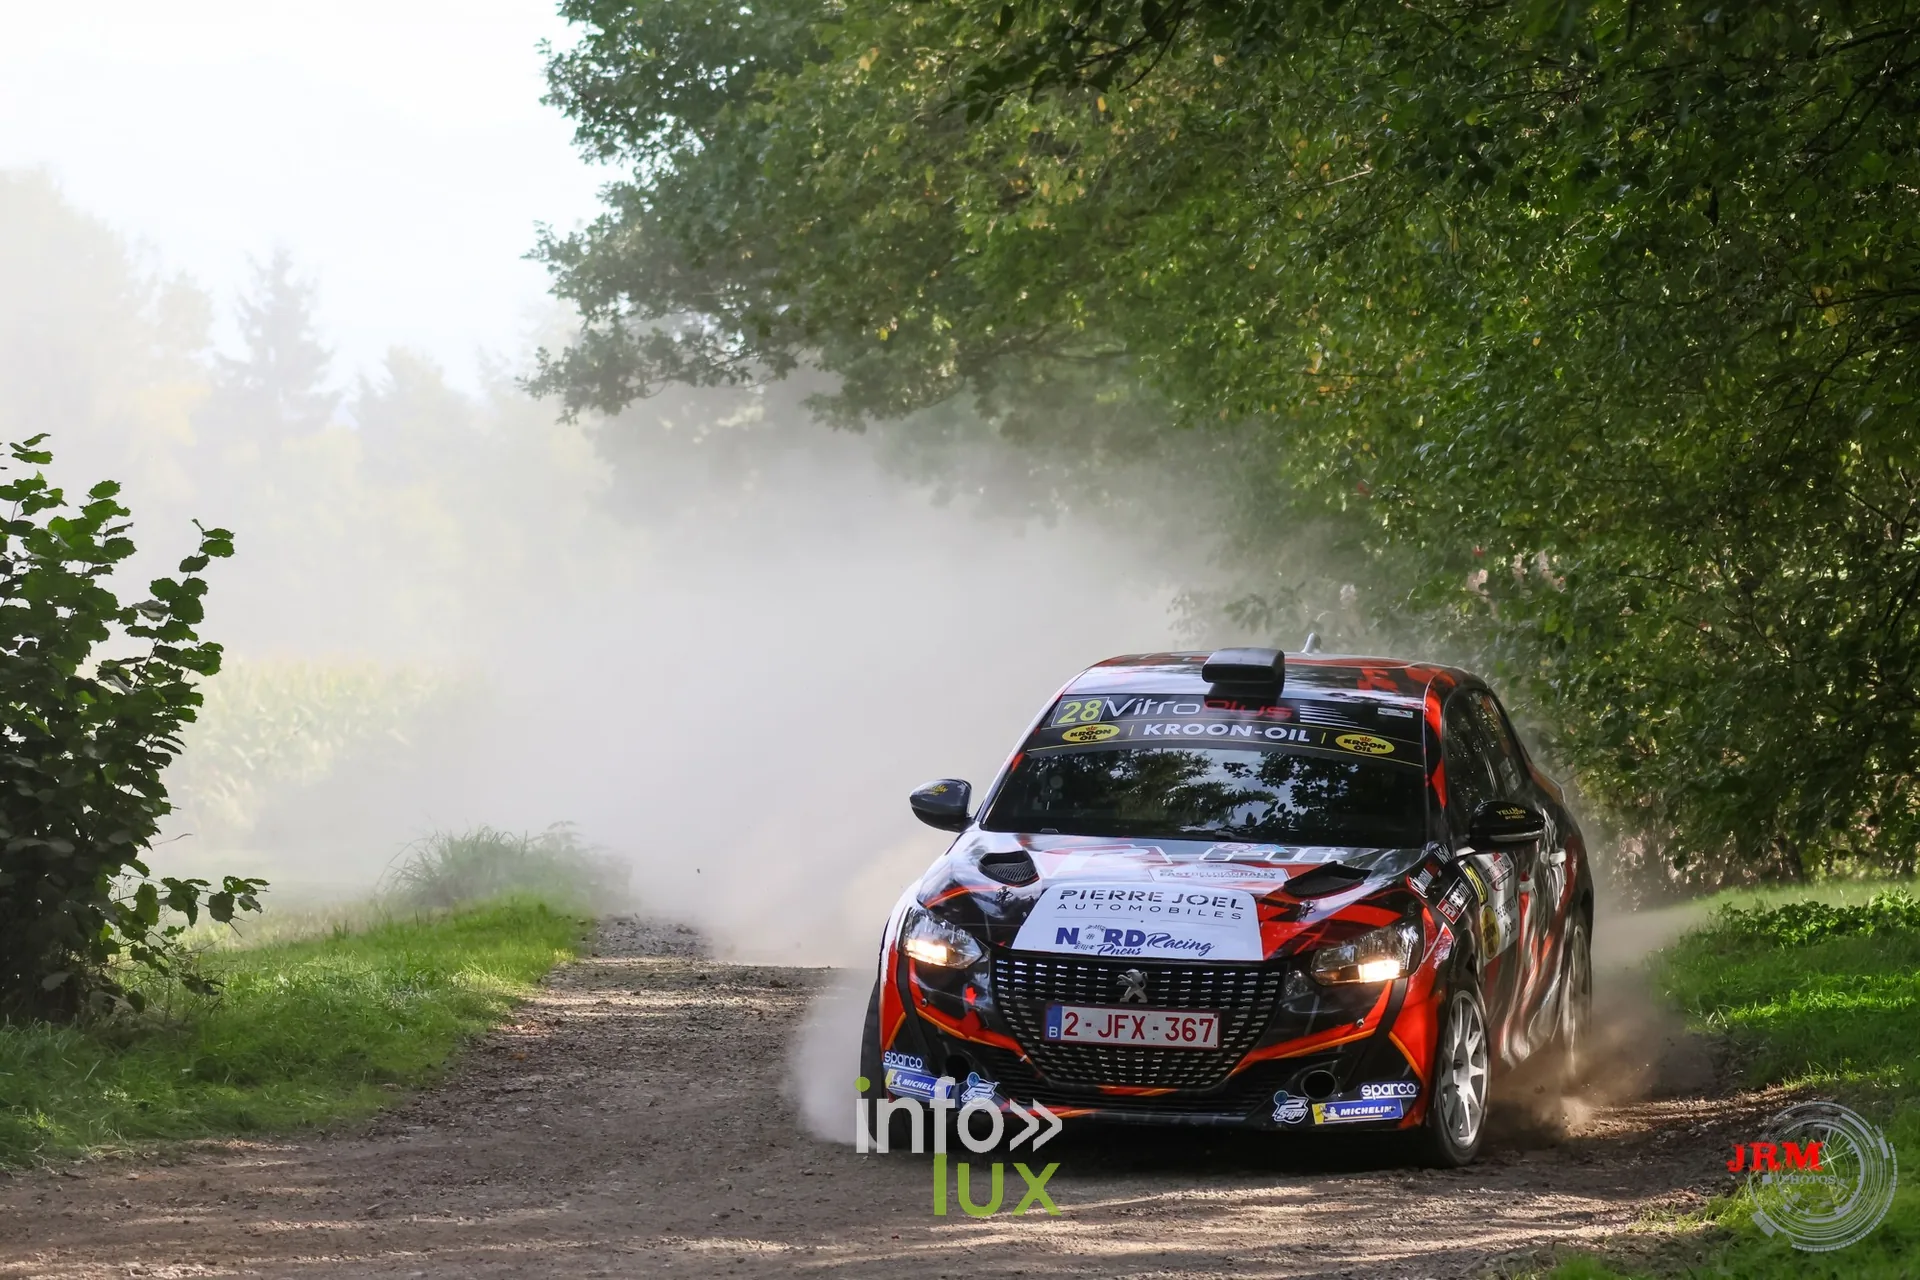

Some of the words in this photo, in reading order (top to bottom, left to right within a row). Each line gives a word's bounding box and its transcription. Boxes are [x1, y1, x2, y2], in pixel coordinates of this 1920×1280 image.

[1057, 700, 1101, 724] 28
[1070, 728, 1112, 738] KROON
[1143, 723, 1311, 743] KROON-OIL
[1343, 738, 1387, 750] KROON
[1353, 745, 1373, 753] OIL
[1060, 889, 1164, 903] PIERRE
[1171, 893, 1244, 910] JOEL
[1057, 903, 1242, 920] AUTOMOBILES
[1097, 942, 1144, 956] Pneus
[1147, 932, 1215, 956] Racing
[1048, 1026, 1058, 1038] B
[884, 1051, 923, 1068] sparco
[1361, 1082, 1416, 1100] sparco
